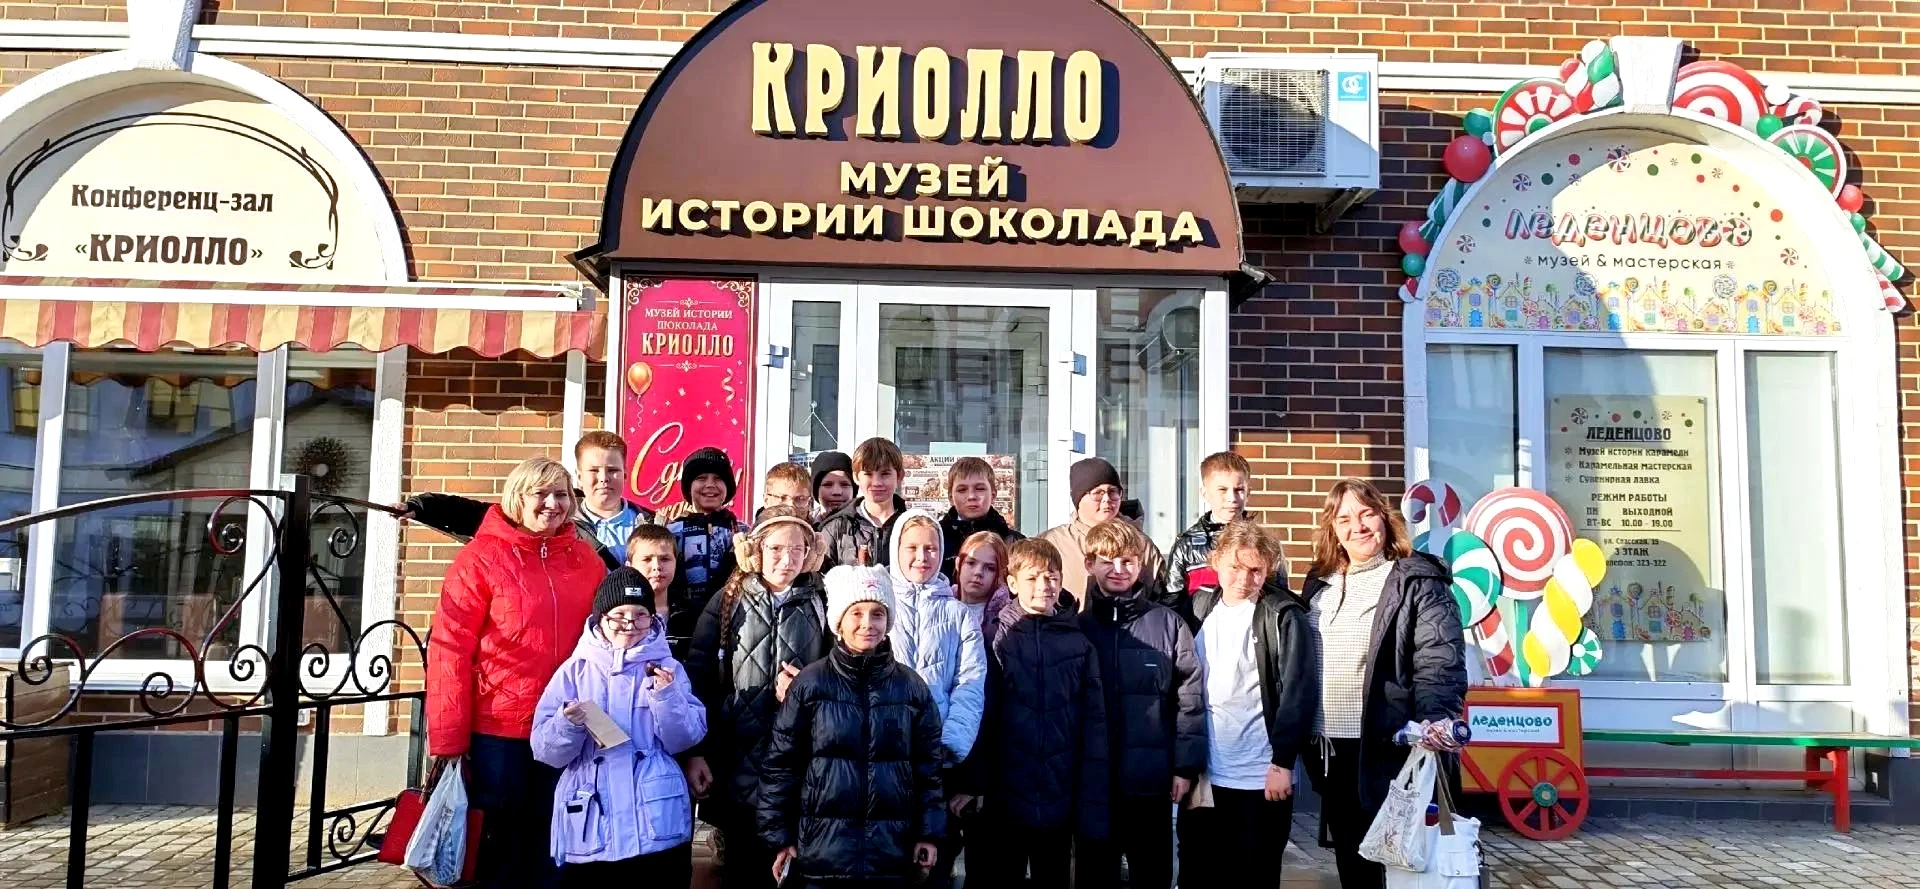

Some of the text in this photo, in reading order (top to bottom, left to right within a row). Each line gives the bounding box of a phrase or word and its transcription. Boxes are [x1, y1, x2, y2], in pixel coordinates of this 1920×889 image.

[751, 41, 1102, 143] КРИОЛЛО
[840, 156, 1009, 198] МУЗЕЙ
[71, 184, 274, 213] Конференц-зал
[641, 198, 1204, 248] ИСТОРИИ ШОКОЛАДА
[75, 234, 263, 266] «КРИОЛЛО»
[1538, 253, 1722, 271] музей & мастерская
[645, 307, 733, 319] МУЗЕЙ ИСТОРИИ
[657, 320, 718, 332] ШОКОЛАДА
[641, 332, 734, 357] КРИОЛЛО
[1586, 426, 1672, 442] ЛЕДЕНЦОВО
[1578, 446, 1689, 457] Музей истории карамели
[1578, 461, 1693, 471] Карамельная мастерская
[1578, 475, 1660, 484] Сувенирная лавка
[1591, 493, 1667, 502] РЕЖИМ РАБОТЫ
[1586, 507, 1673, 516] ПН ВЫХОДНОЙ
[1586, 519, 1612, 527] ВТ-ВС
[1621, 519, 1643, 527] 10.00
[1623, 547, 1649, 556] ЭТАЖ
